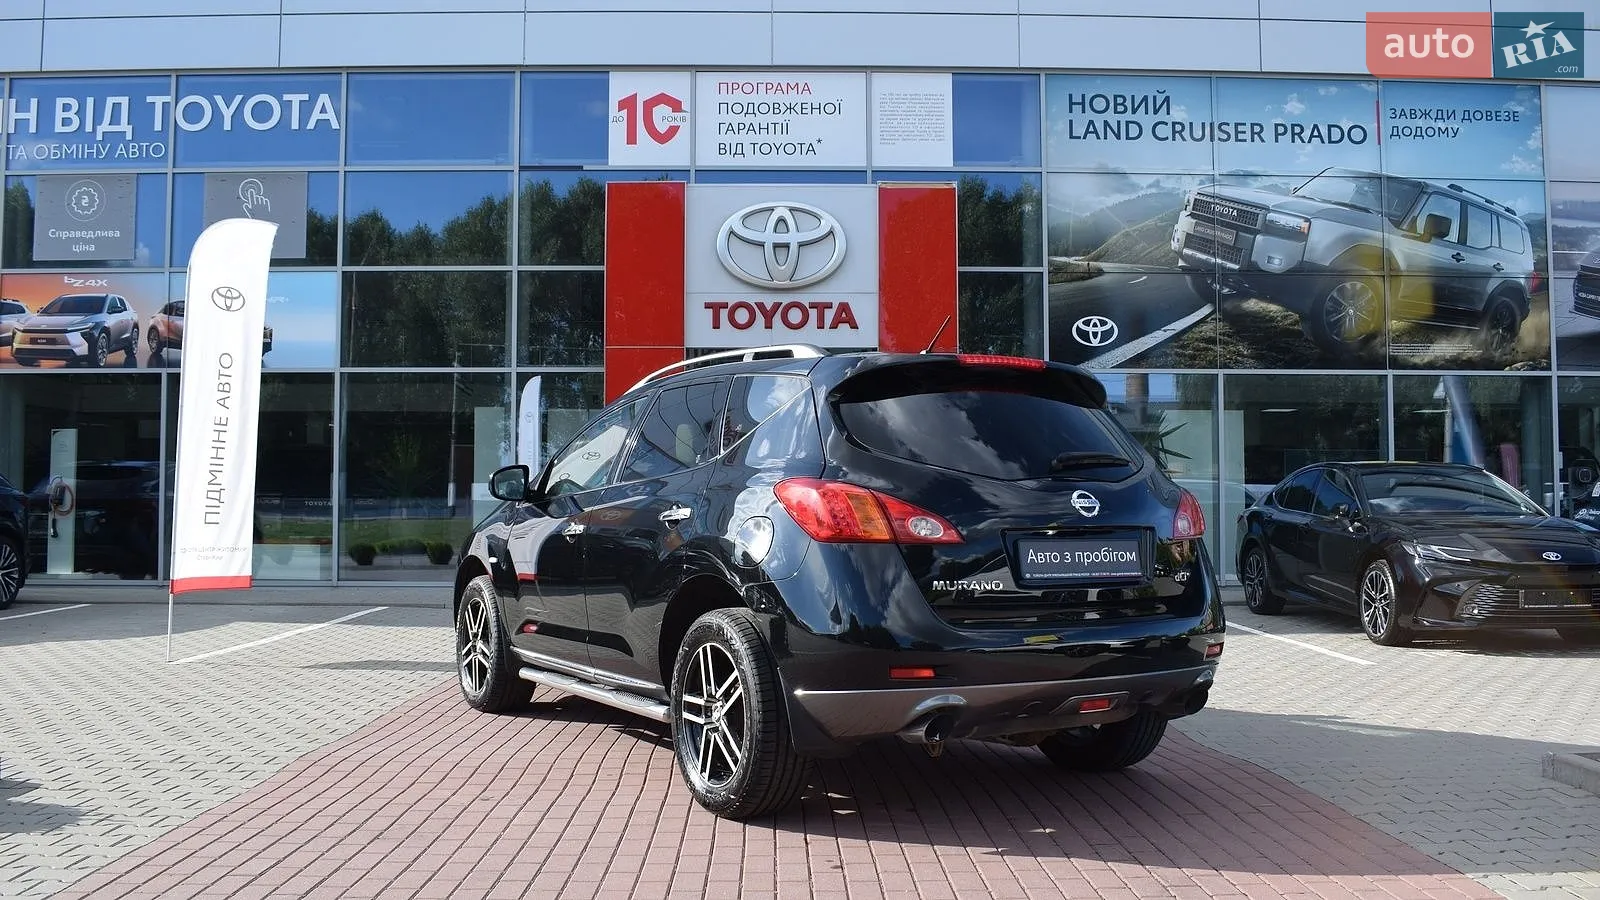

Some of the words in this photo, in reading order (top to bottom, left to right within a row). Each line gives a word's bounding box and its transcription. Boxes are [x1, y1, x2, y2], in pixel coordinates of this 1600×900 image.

[718, 82, 811, 95] ПРОГРАМА
[718, 99, 843, 117] ПОДОВЖЕНОЇ
[1068, 89, 1170, 115] НОВИЙ
[54, 96, 133, 140] ВІД
[147, 94, 340, 132] TOYOTA
[1389, 107, 1456, 123] ЗАВЖДИ
[1461, 109, 1520, 123] ДОВЕЗЕ
[718, 119, 790, 135] ГАРАНТІЇ
[1068, 119, 1143, 141] LAND
[1151, 120, 1265, 143] CRUISER
[1274, 122, 1368, 145] PRADO
[1389, 125, 1460, 140] ДОДОМУ
[7, 144, 27, 160] ТА
[33, 143, 111, 160] ОБМІНУ
[115, 142, 165, 159] АВТО
[718, 142, 745, 158] ВІД
[1210, 204, 1238, 217] TOYOTA
[48, 228, 121, 240] Справедлива
[72, 242, 96, 253] ціна
[704, 300, 859, 330] TOYOTA
[215, 352, 234, 410] АВТО
[204, 416, 230, 525] ПІДМІННЕ
[1027, 549, 1060, 563] Авто
[1064, 553, 1071, 562] з
[1075, 547, 1137, 565] пробігом
[932, 580, 1003, 591] MURANO
